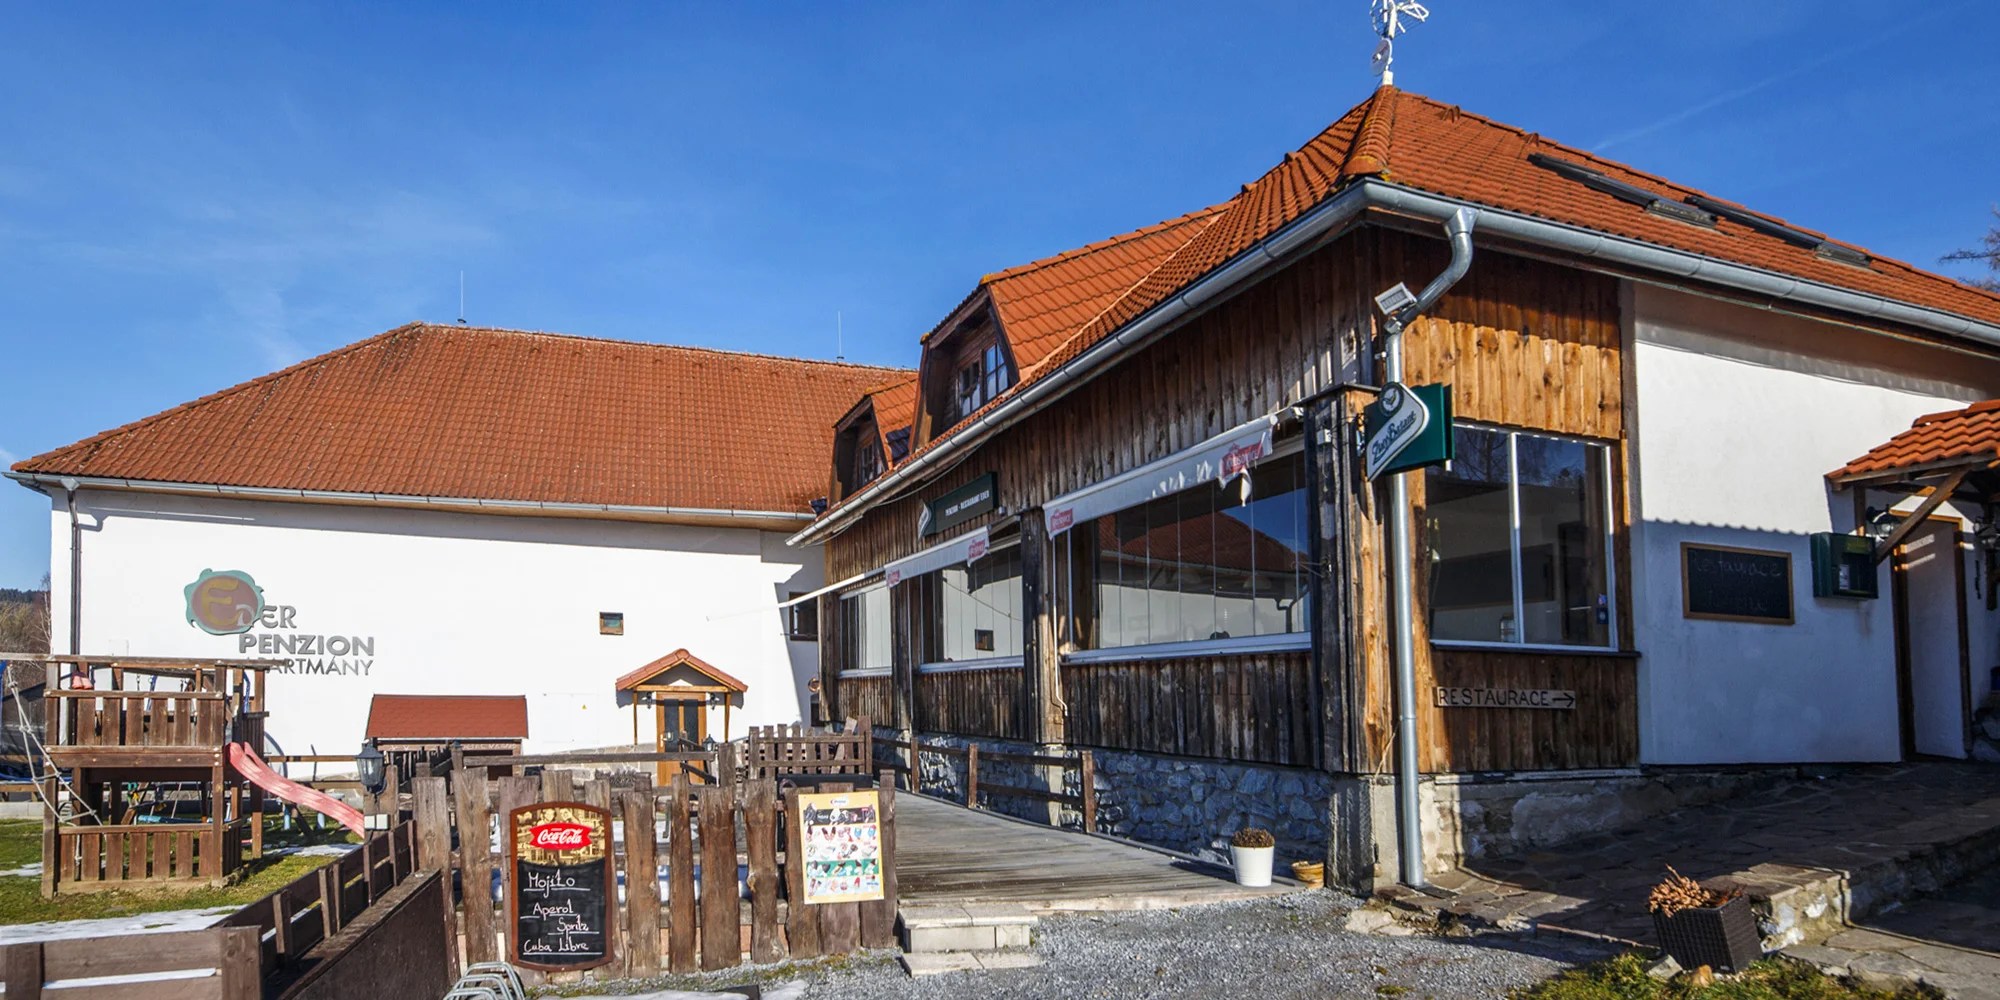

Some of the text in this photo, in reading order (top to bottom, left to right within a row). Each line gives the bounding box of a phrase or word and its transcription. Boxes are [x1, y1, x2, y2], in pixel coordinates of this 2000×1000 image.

[239, 633, 374, 656] PENZION
[1439, 687, 1549, 706] RESTAURACE
[537, 828, 583, 845] Coca-Cola
[528, 869, 575, 898] Mojito
[533, 899, 573, 921] Aperol
[557, 914, 589, 941] Spritz
[523, 936, 589, 953] Cuba Libre
